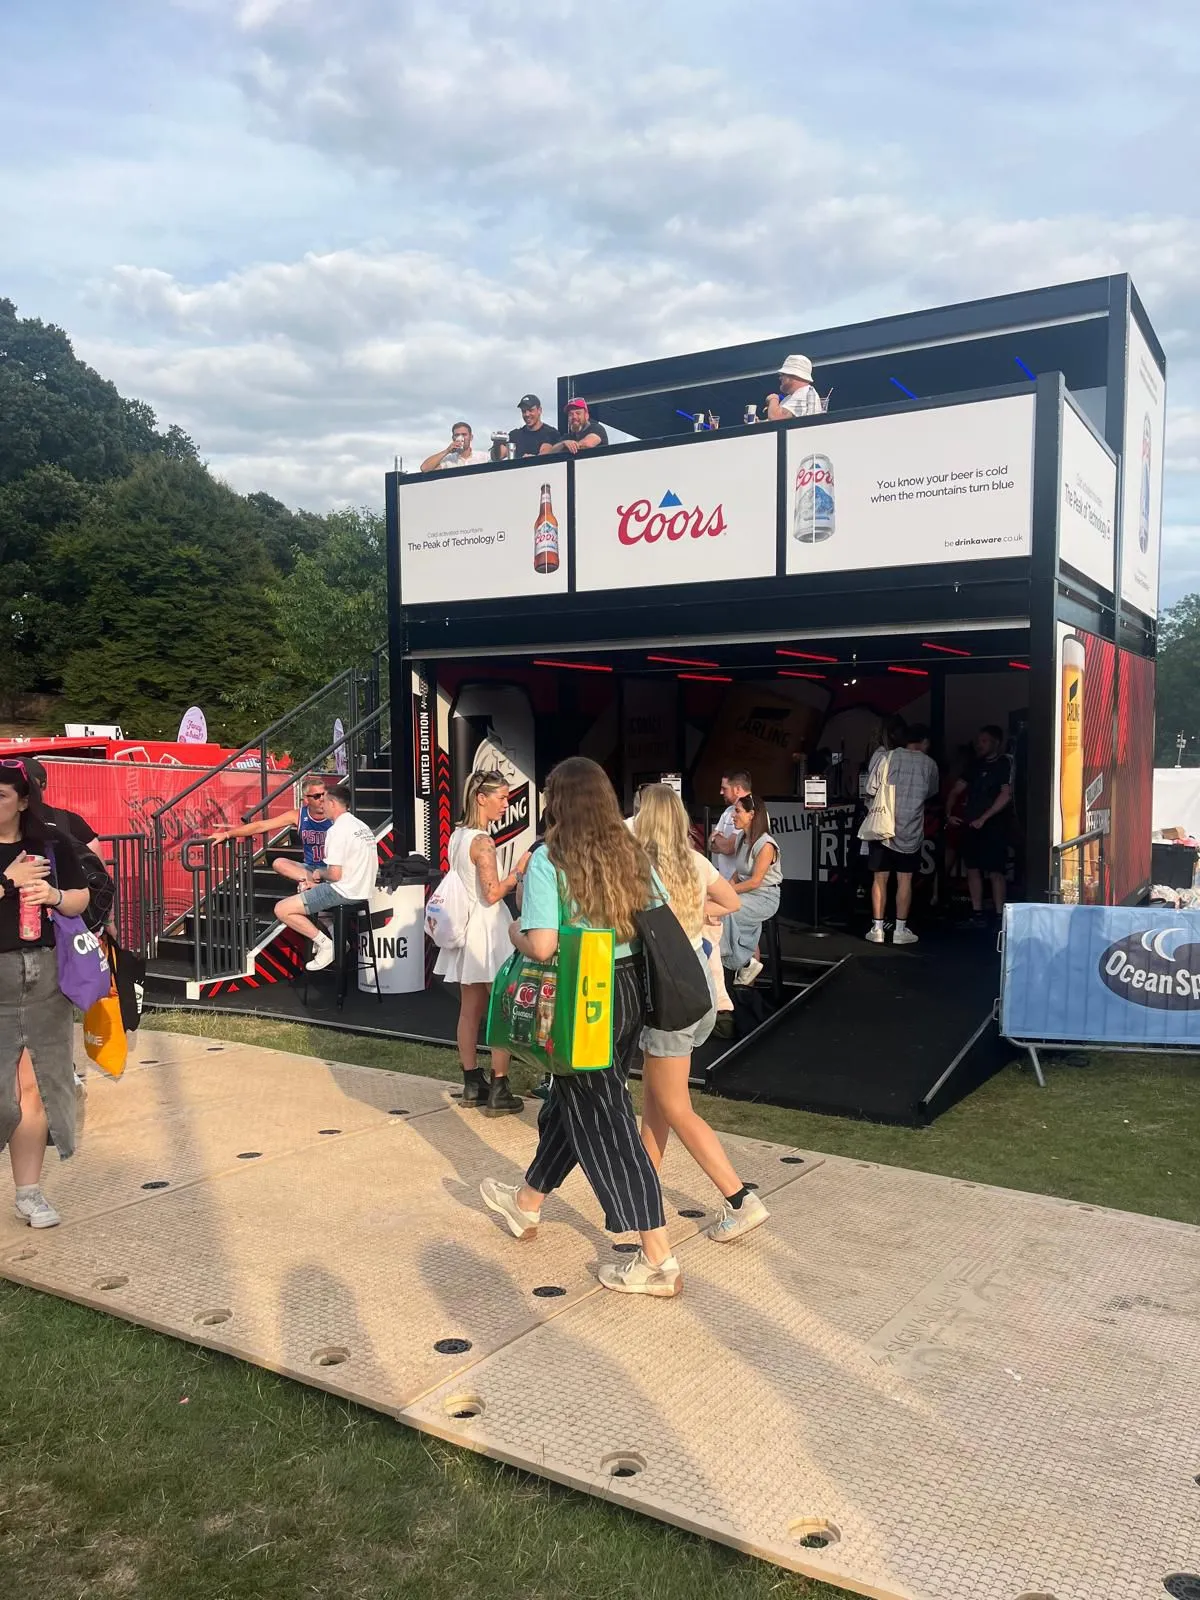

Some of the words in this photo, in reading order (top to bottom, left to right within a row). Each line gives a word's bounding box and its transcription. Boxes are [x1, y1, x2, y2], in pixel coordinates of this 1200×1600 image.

[870, 493, 897, 504] when
[898, 490, 914, 501] the
[916, 485, 967, 499] mountains
[969, 483, 990, 493] turn
[992, 480, 1014, 491] blue
[877, 480, 896, 489] You
[897, 477, 924, 487] know
[926, 473, 949, 486] your
[950, 470, 974, 481] beer
[976, 468, 983, 478] is
[985, 465, 1008, 477] cold
[616, 499, 727, 546] Coors
[408, 542, 421, 551] The
[423, 540, 441, 550] Peak
[442, 538, 450, 548] of
[452, 535, 496, 547] Technology
[420, 711, 429, 750] EDITION
[421, 754, 430, 795] LIMITED
[1105, 950, 1173, 994] Ocean
